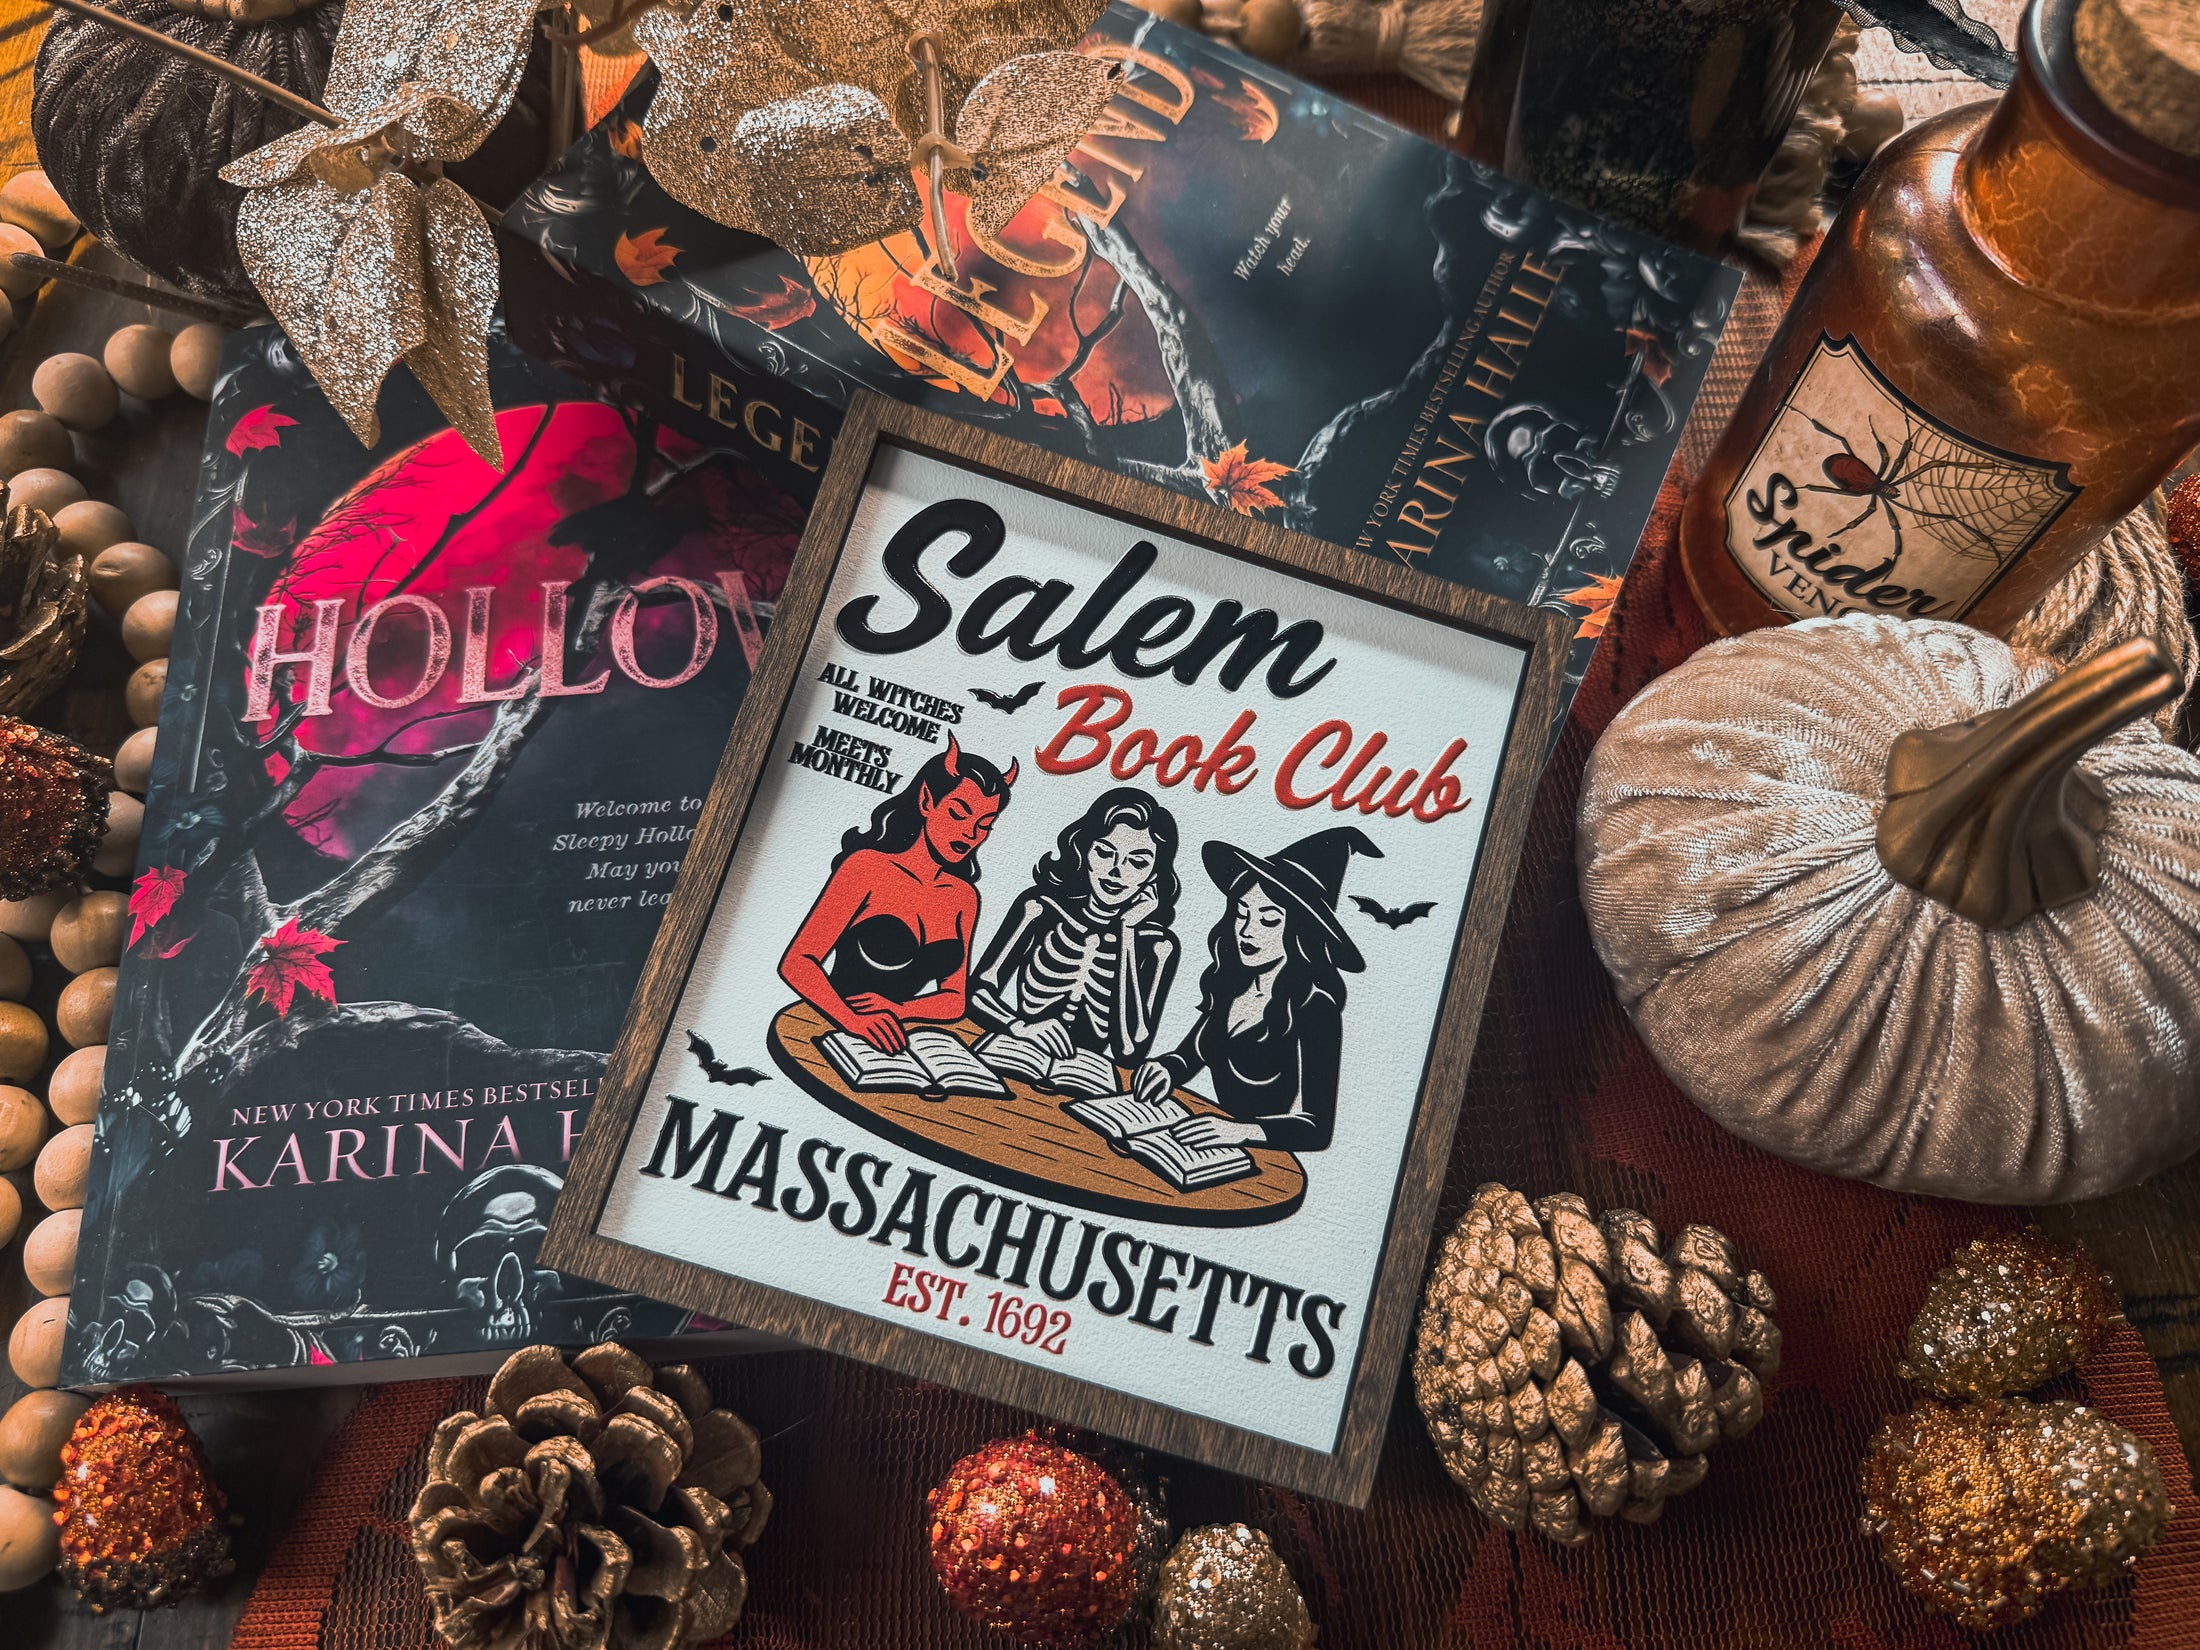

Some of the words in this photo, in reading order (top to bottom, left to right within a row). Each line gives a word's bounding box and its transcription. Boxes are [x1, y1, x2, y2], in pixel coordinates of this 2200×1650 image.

[1233, 236, 1271, 281] Watch
[1264, 198, 1292, 239] your
[1276, 236, 1311, 277] head.
[672, 352, 838, 473] LEGE
[1366, 479, 1402, 528] YORK
[1391, 423, 1429, 477] TIMES
[1419, 318, 1481, 425] BESTSELLING
[1473, 250, 1516, 320] AUTHOR
[1746, 472, 1956, 616] Spider
[836, 499, 1338, 700] Salem
[1769, 549, 1866, 618] VEN
[817, 662, 860, 693] ALL
[867, 675, 965, 725] WITCHES
[832, 690, 942, 744] WELCOME
[788, 741, 903, 795] MONTHLY
[811, 725, 893, 768] MEETS
[1034, 683, 1260, 796] Book
[1274, 718, 1472, 824] Club
[575, 800, 672, 820] Welcome
[680, 795, 703, 813] to
[552, 833, 630, 852] Sleepy
[585, 861, 639, 881] May
[568, 895, 632, 913] never
[231, 1102, 297, 1127] NEW
[304, 1096, 382, 1120] YORK
[389, 1088, 475, 1114] TIMES
[207, 1113, 522, 1193] KARINA
[638, 1092, 1345, 1379] MASSACHUSETTS
[882, 1261, 971, 1328] EST.
[982, 1290, 1073, 1356] 1692
